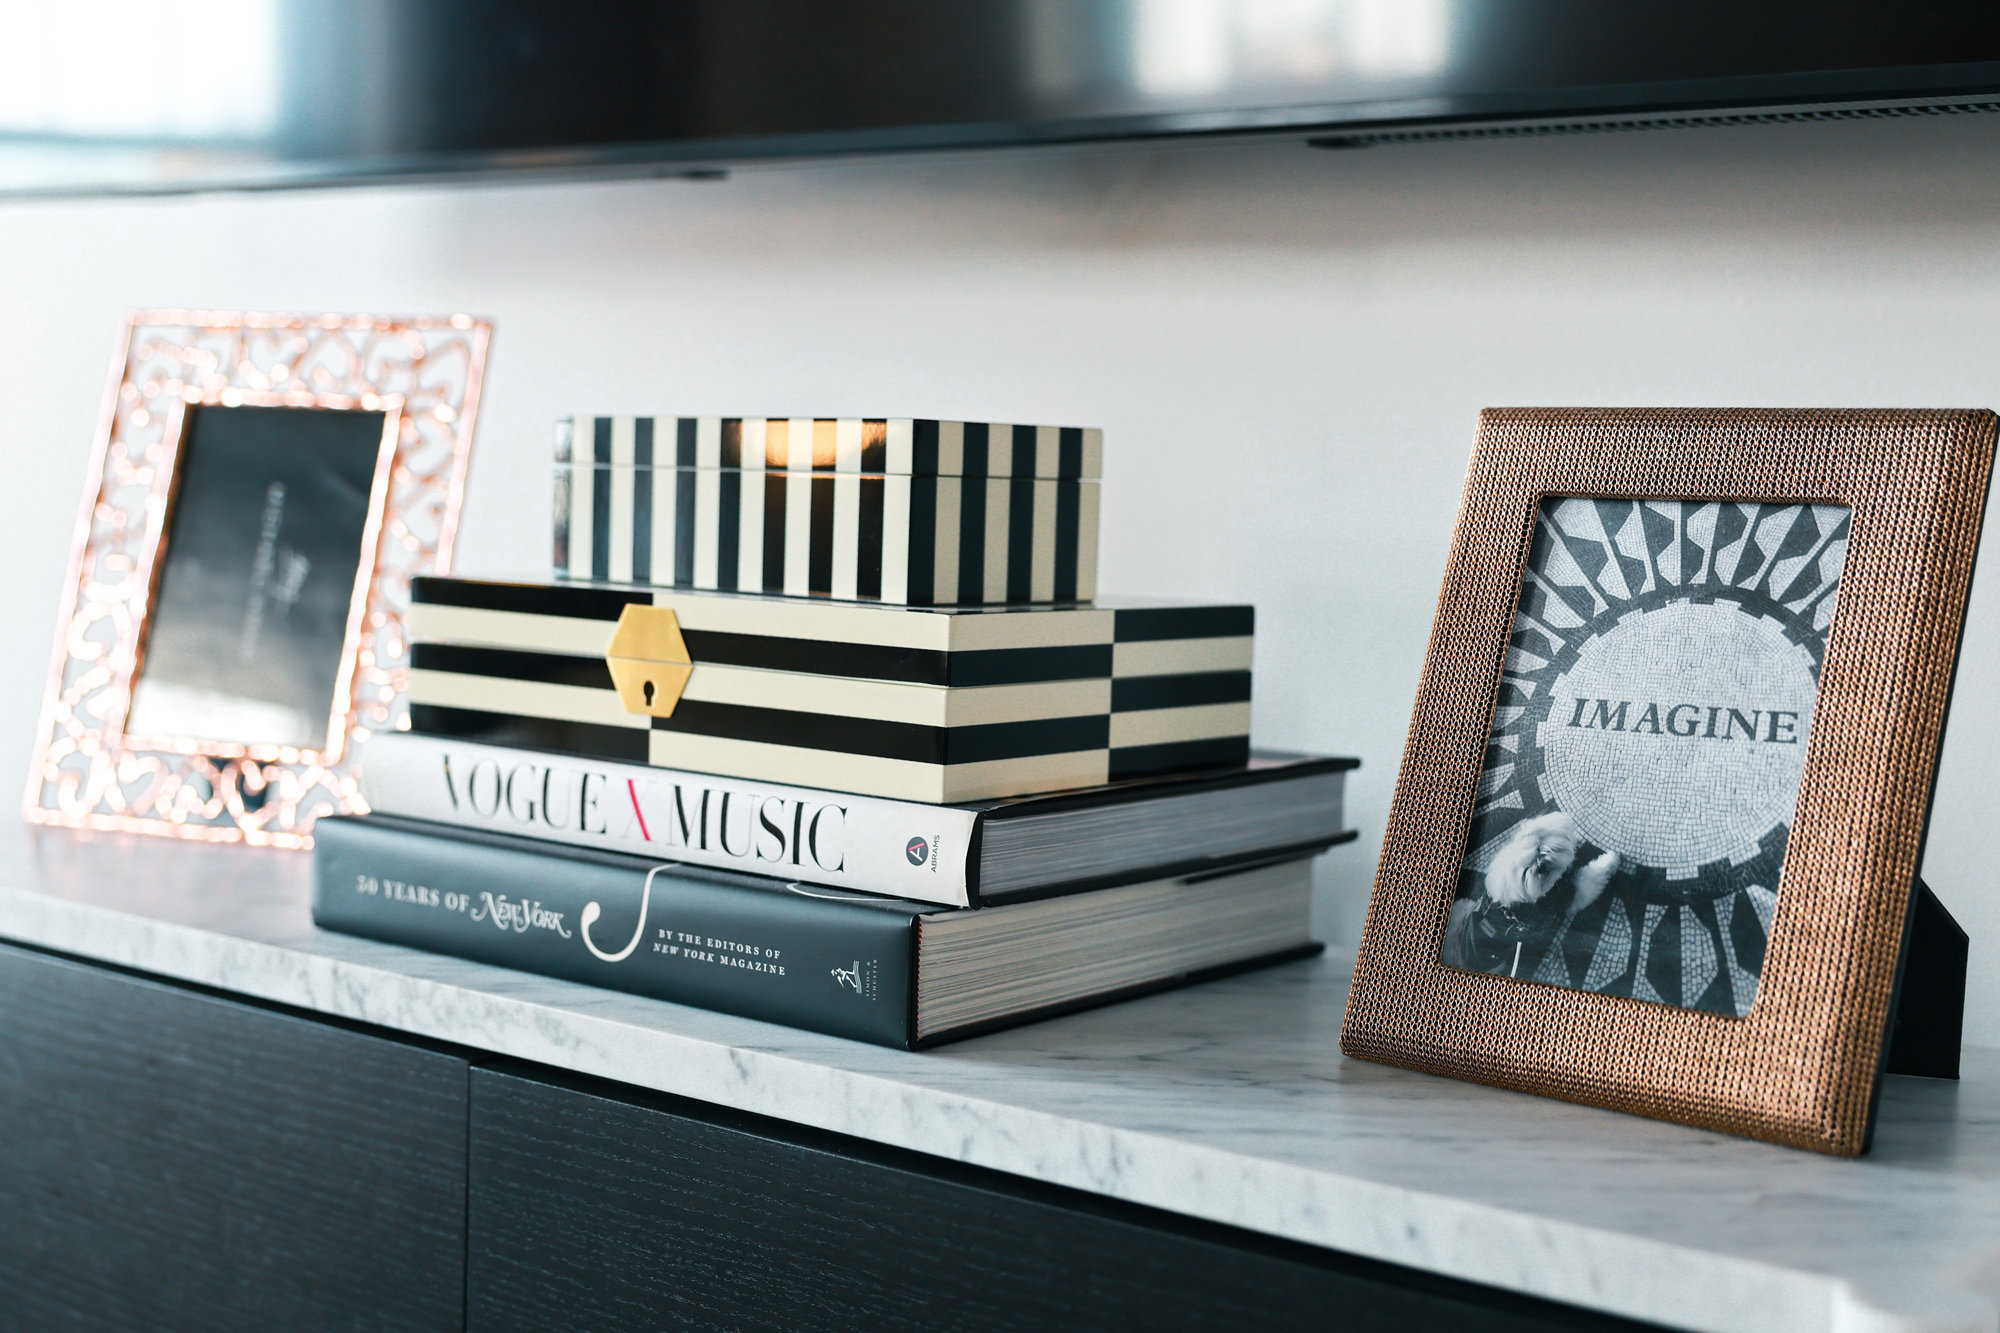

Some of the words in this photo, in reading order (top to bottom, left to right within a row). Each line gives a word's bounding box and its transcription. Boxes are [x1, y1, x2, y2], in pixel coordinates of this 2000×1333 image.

[1567, 698, 1799, 744] IMAGINE
[442, 753, 608, 835] VOGUE
[619, 776, 658, 844] X
[664, 782, 849, 874] MUSIC
[930, 834, 941, 874] ABRAMS
[355, 874, 379, 897] 50
[382, 878, 440, 908] YEARS
[443, 891, 470, 913] OF
[652, 942, 680, 955] NEW
[683, 948, 715, 962] YORK
[719, 955, 786, 976] MAGAZINE
[658, 928, 673, 940] BY
[678, 932, 702, 945] THE
[706, 937, 760, 956] EDITORS
[765, 948, 781, 960] OF
